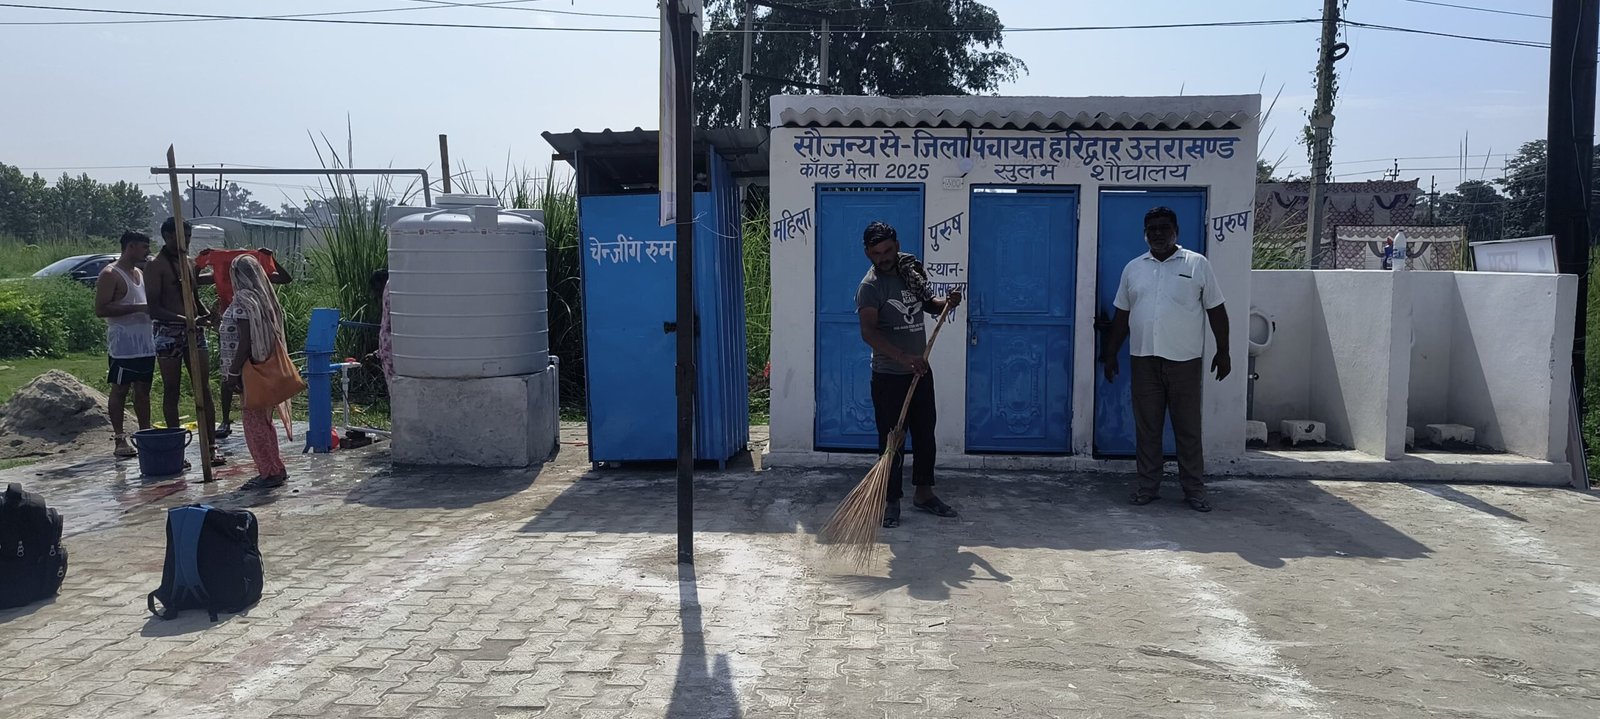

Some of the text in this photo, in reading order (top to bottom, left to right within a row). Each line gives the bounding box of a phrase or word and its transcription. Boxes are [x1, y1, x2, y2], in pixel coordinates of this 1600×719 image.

[793, 127, 879, 158] सौजन्य
[972, 130, 1047, 160] पंचायत
[1049, 131, 1123, 166] हरिद्वार
[1127, 136, 1240, 161] उत्तराखण्ड
[845, 158, 880, 180] मेला
[885, 163, 930, 179] 2025
[993, 158, 1191, 182] सुलभ शौचालय
[773, 207, 812, 243] महिला
[928, 211, 964, 252] पुरुष
[1211, 210, 1252, 242] पुरुष
